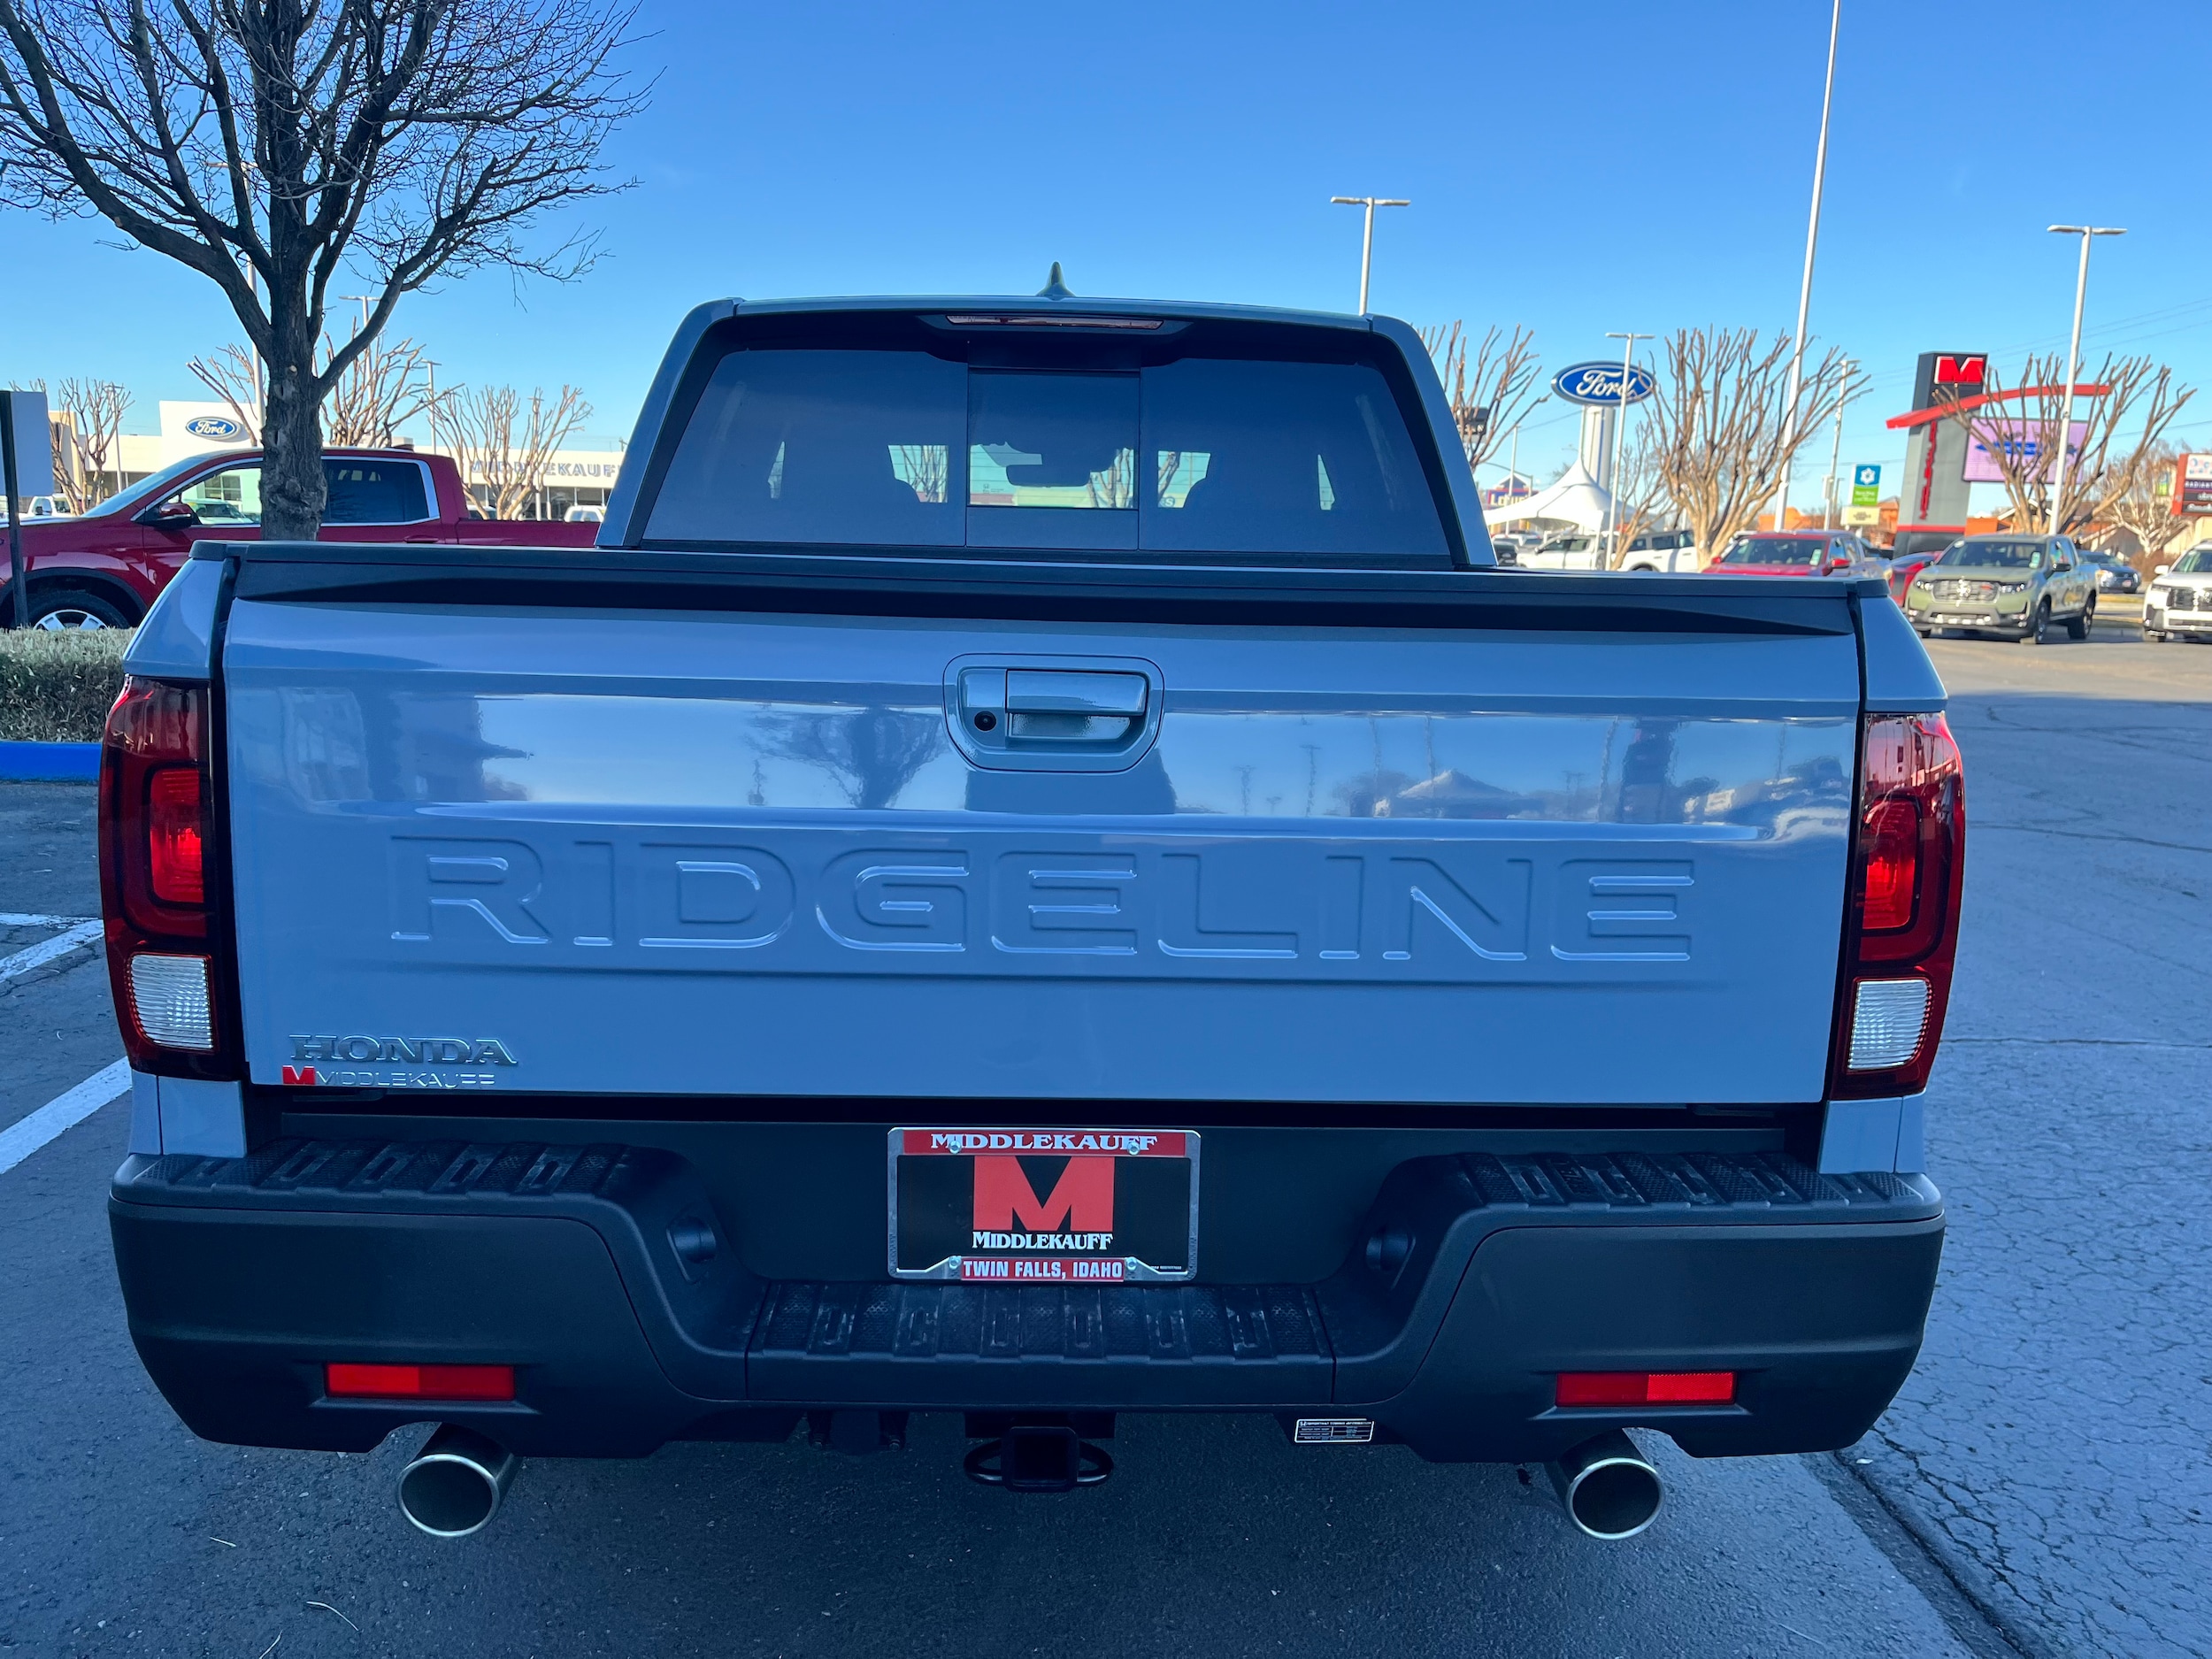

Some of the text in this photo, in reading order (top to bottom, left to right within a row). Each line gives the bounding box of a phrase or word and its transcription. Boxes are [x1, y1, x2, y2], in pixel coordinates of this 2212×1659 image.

[1576, 369, 1637, 397] Ford
[196, 420, 227, 434] Ford
[390, 835, 1694, 962] RIDGELINE
[288, 1033, 518, 1066] HONDA
[316, 1071, 495, 1088] MIDDLEKAUFF
[930, 1133, 1158, 1151] MIDDLEKAUFF
[974, 1156, 1115, 1231] M
[972, 1232, 1113, 1250] MIDDLEKAUFF
[963, 1261, 1123, 1279] TWIN FALLS, IDAHO
